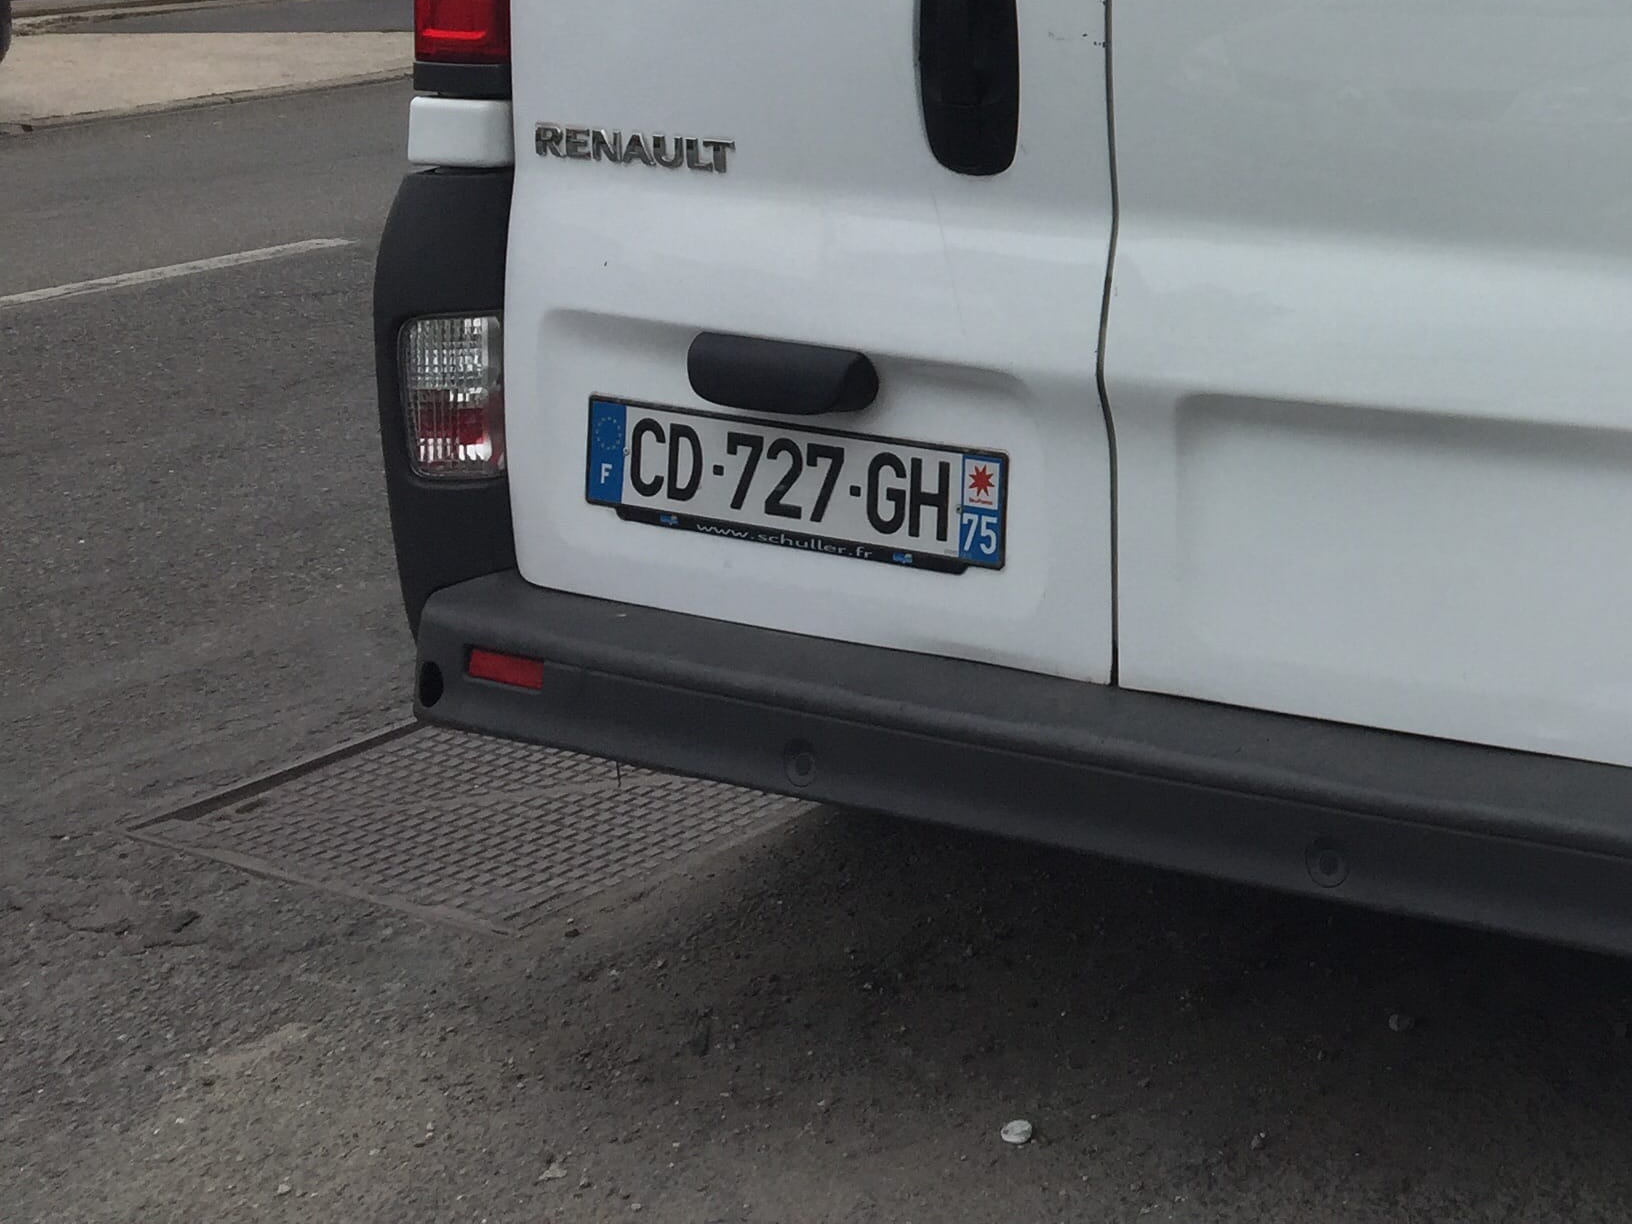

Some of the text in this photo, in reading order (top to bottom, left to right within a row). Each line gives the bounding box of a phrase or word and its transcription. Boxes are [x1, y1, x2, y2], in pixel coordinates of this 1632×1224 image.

[534, 123, 736, 174] RENAULT
[600, 463, 612, 484] F
[630, 417, 951, 542] CD-727-GH
[696, 522, 873, 559] www.schuller.fr
[961, 512, 998, 555] 75
